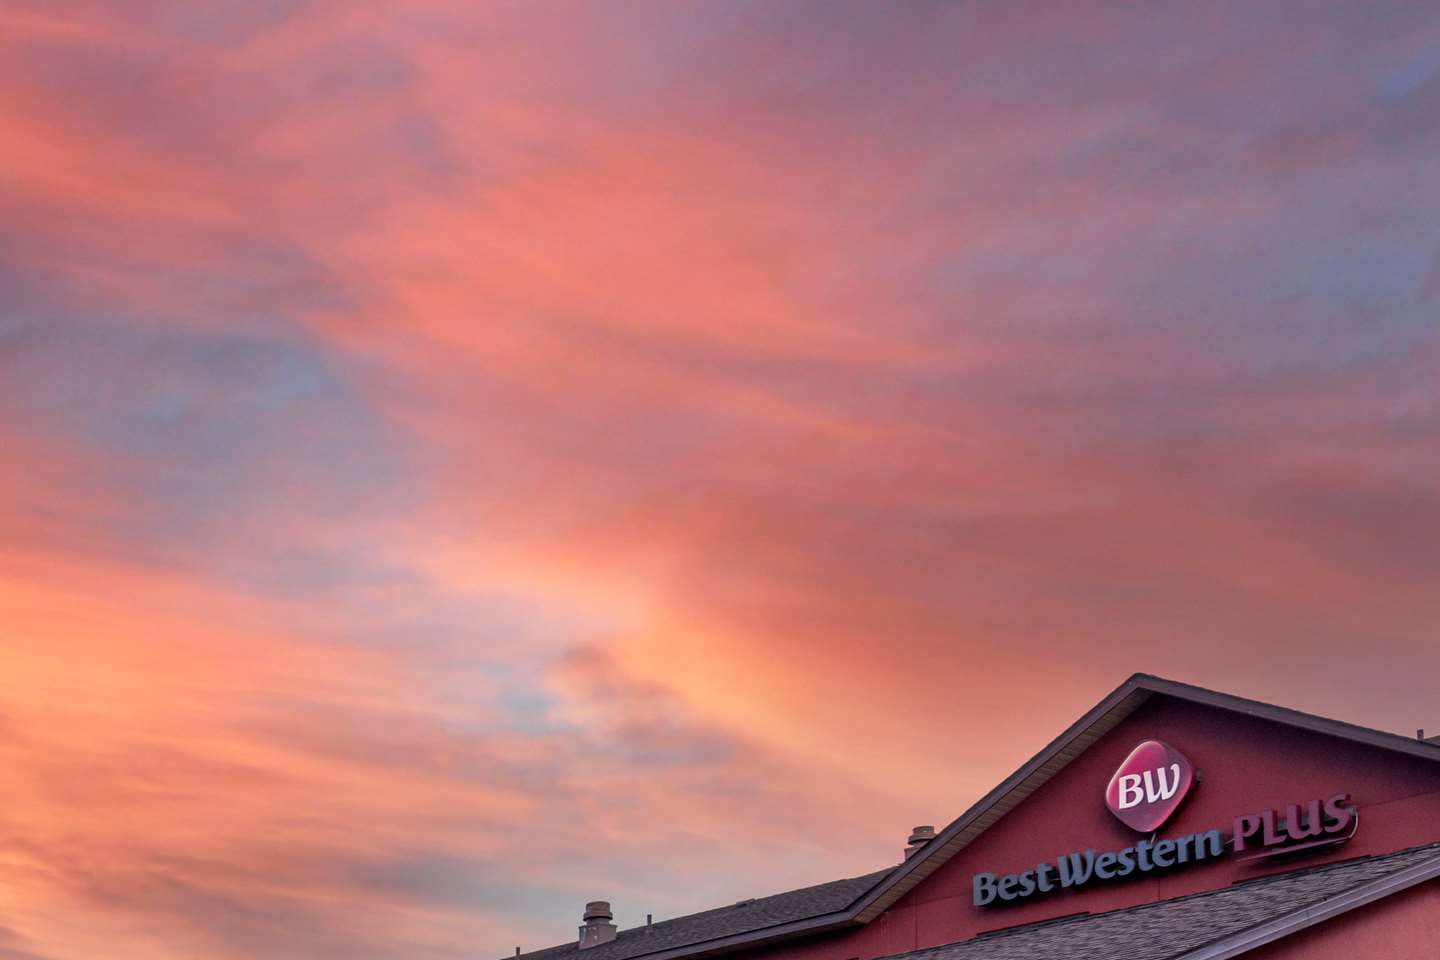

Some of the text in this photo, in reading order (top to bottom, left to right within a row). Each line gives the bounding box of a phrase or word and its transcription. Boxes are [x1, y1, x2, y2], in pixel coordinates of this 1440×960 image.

[1117, 763, 1180, 809] BW
[972, 794, 1351, 907] Best Western PLUS
